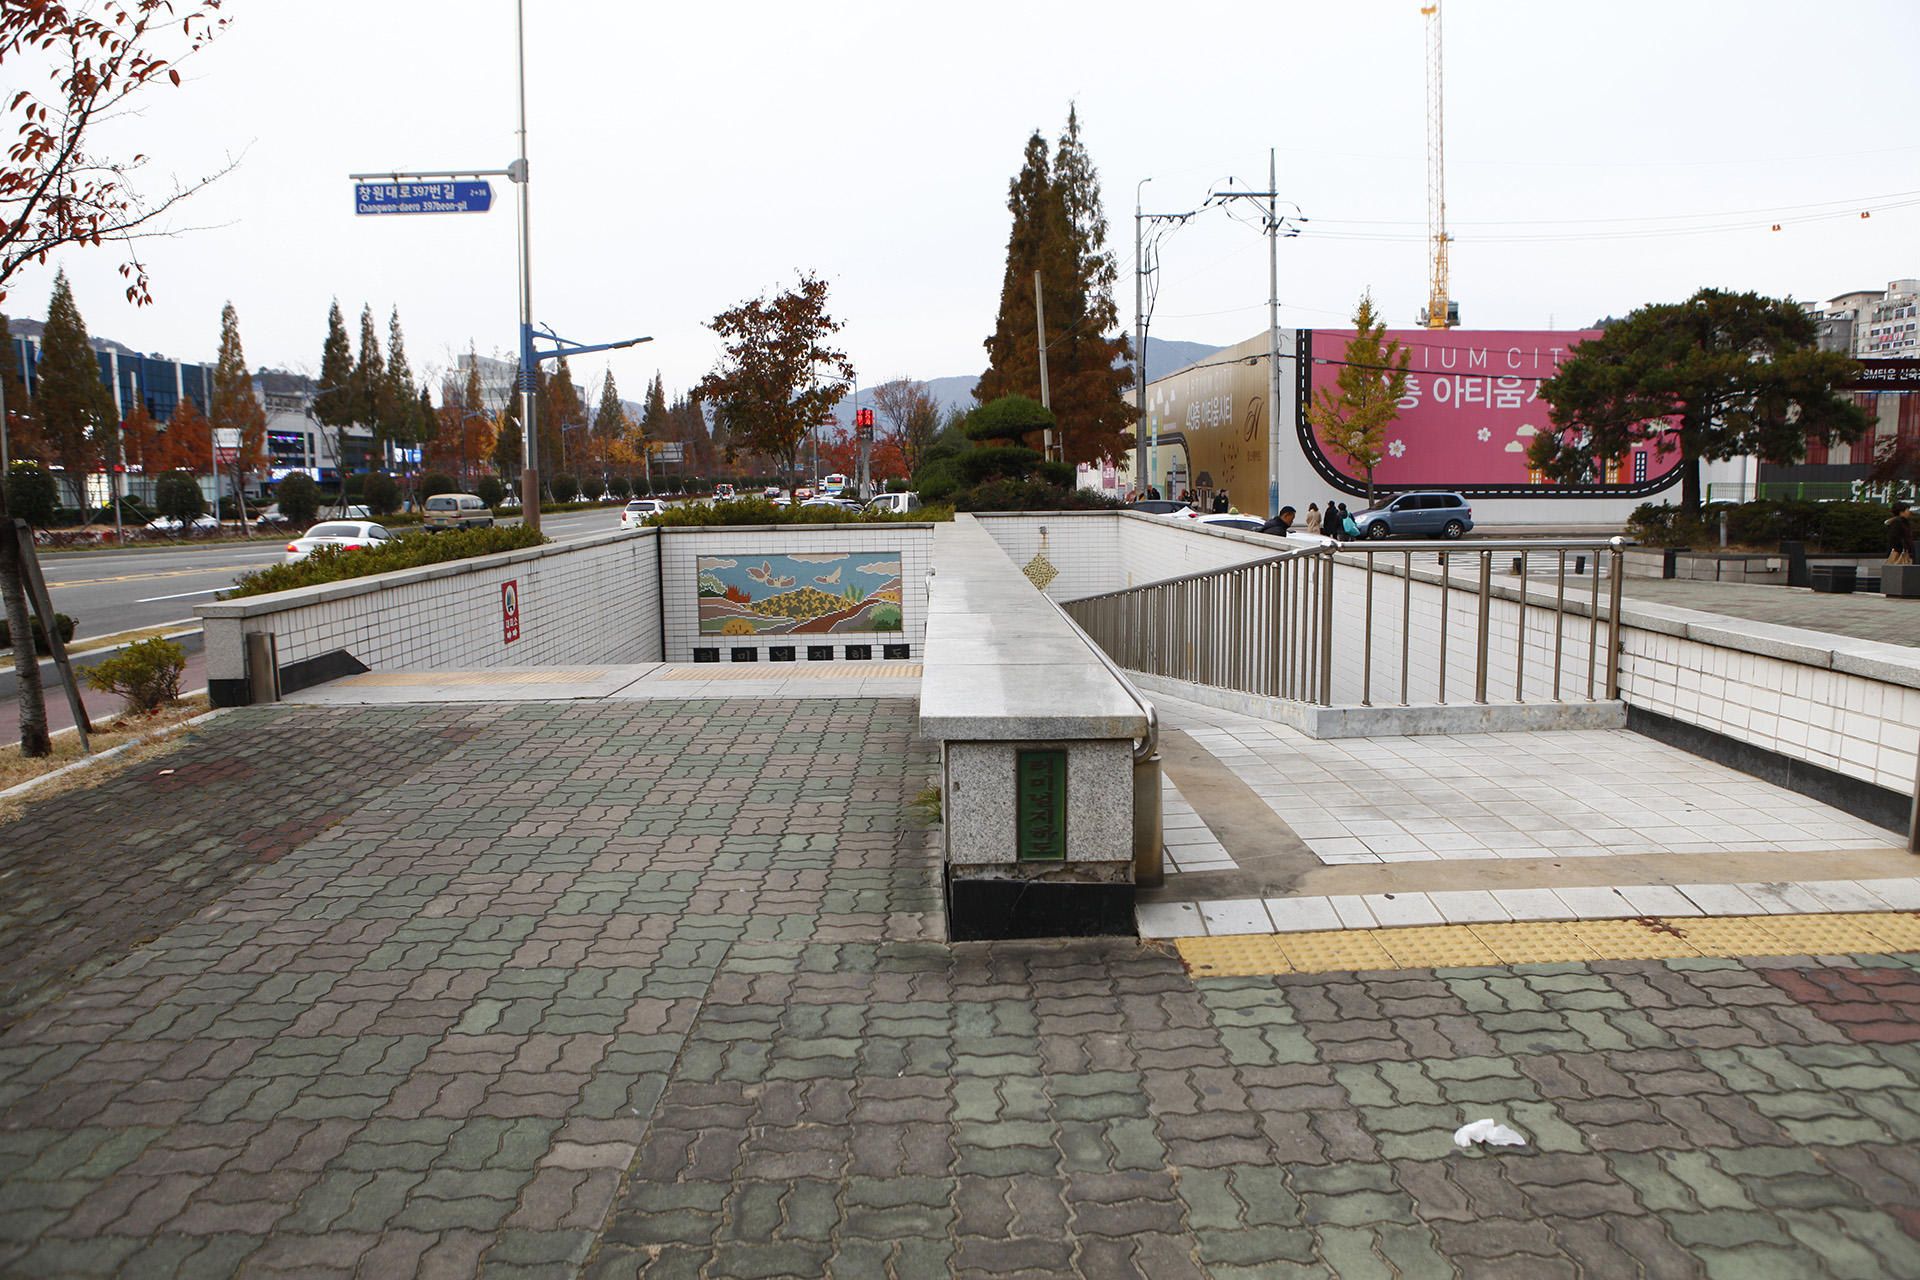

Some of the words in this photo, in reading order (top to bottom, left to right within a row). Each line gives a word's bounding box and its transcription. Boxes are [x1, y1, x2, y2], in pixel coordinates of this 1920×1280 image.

[358, 184, 455, 202] 창원대로397번길
[358, 203, 421, 214] Changwon-daero
[422, 200, 468, 212] 397beon-gil
[1027, 758, 1059, 855] 터미널지하도
